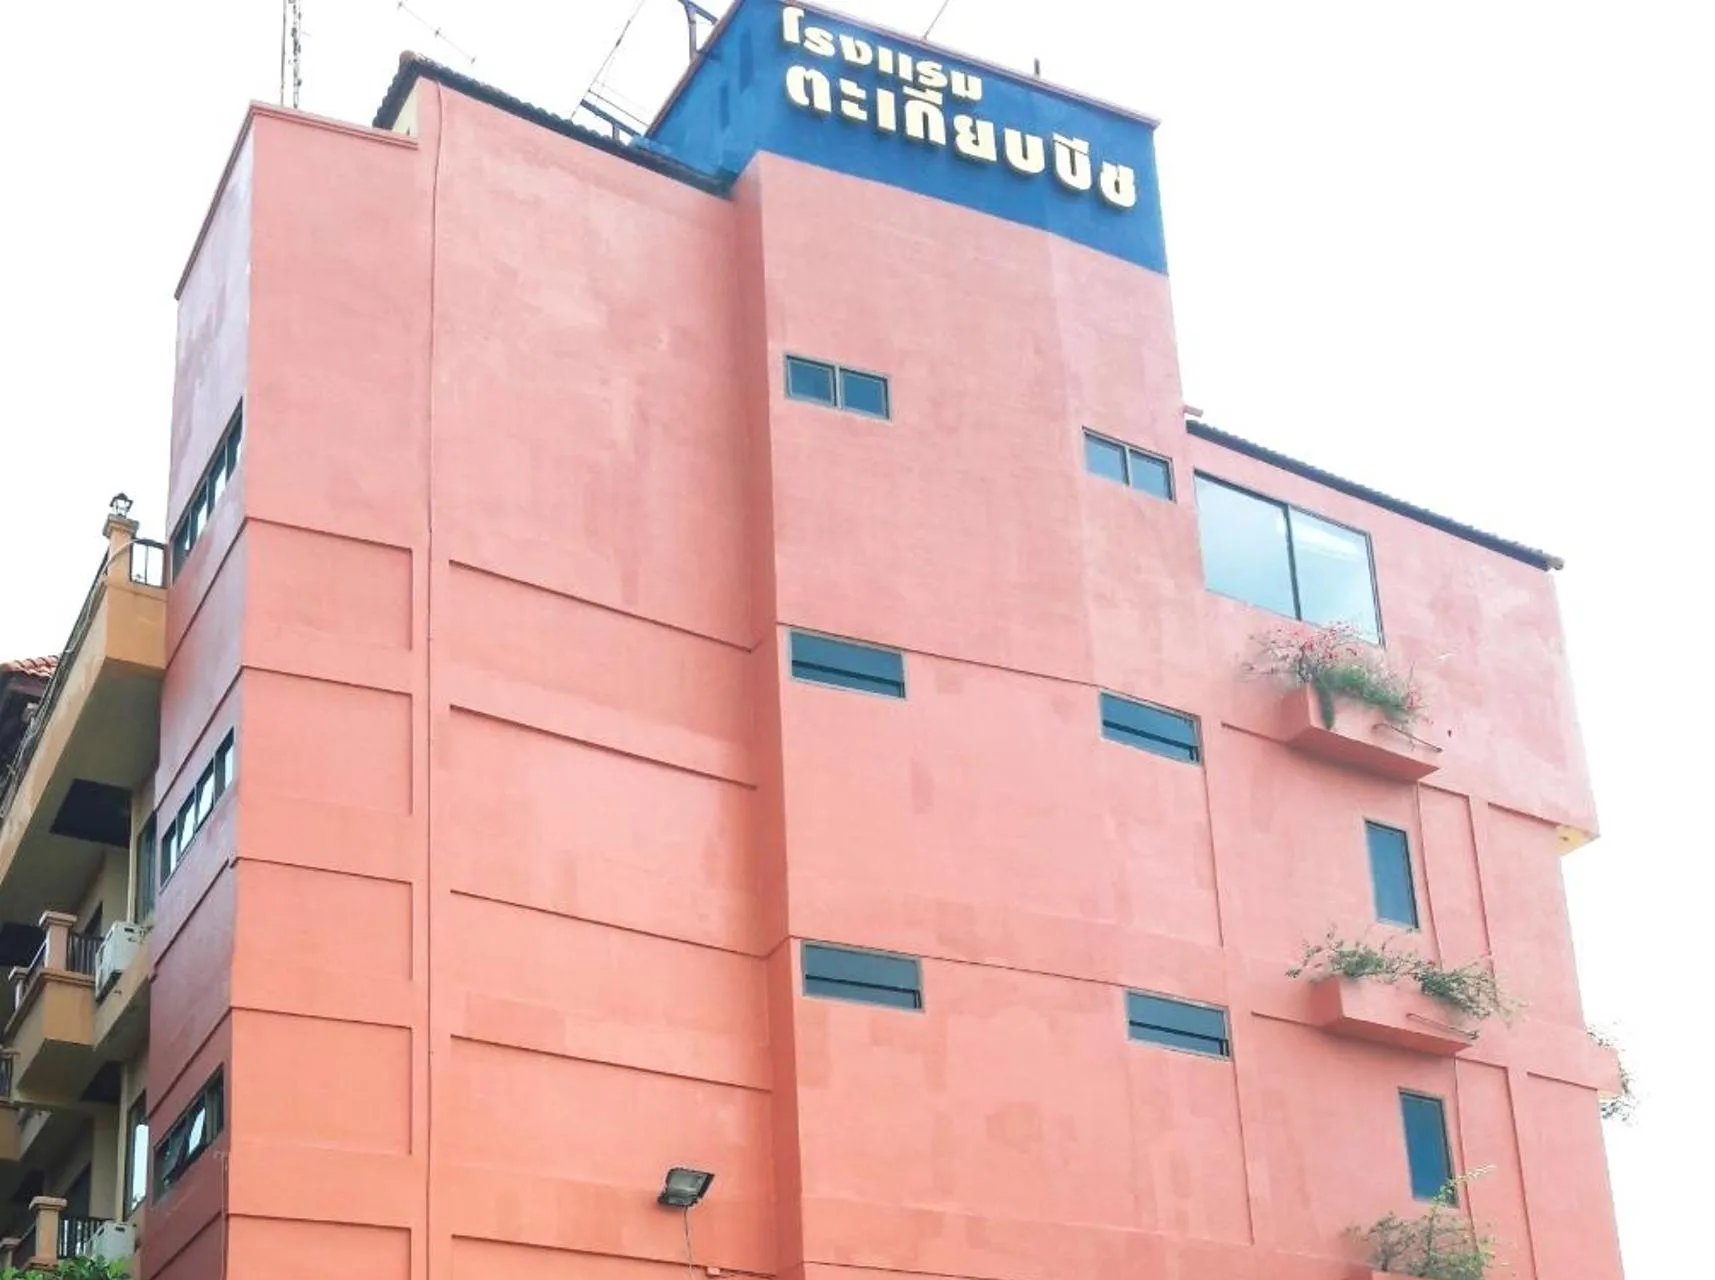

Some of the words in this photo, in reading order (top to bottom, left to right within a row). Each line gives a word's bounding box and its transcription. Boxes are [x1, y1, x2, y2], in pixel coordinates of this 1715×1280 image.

[780, 5, 983, 101] โรงแรม
[785, 65, 1137, 208] ตะเกียบบีช
